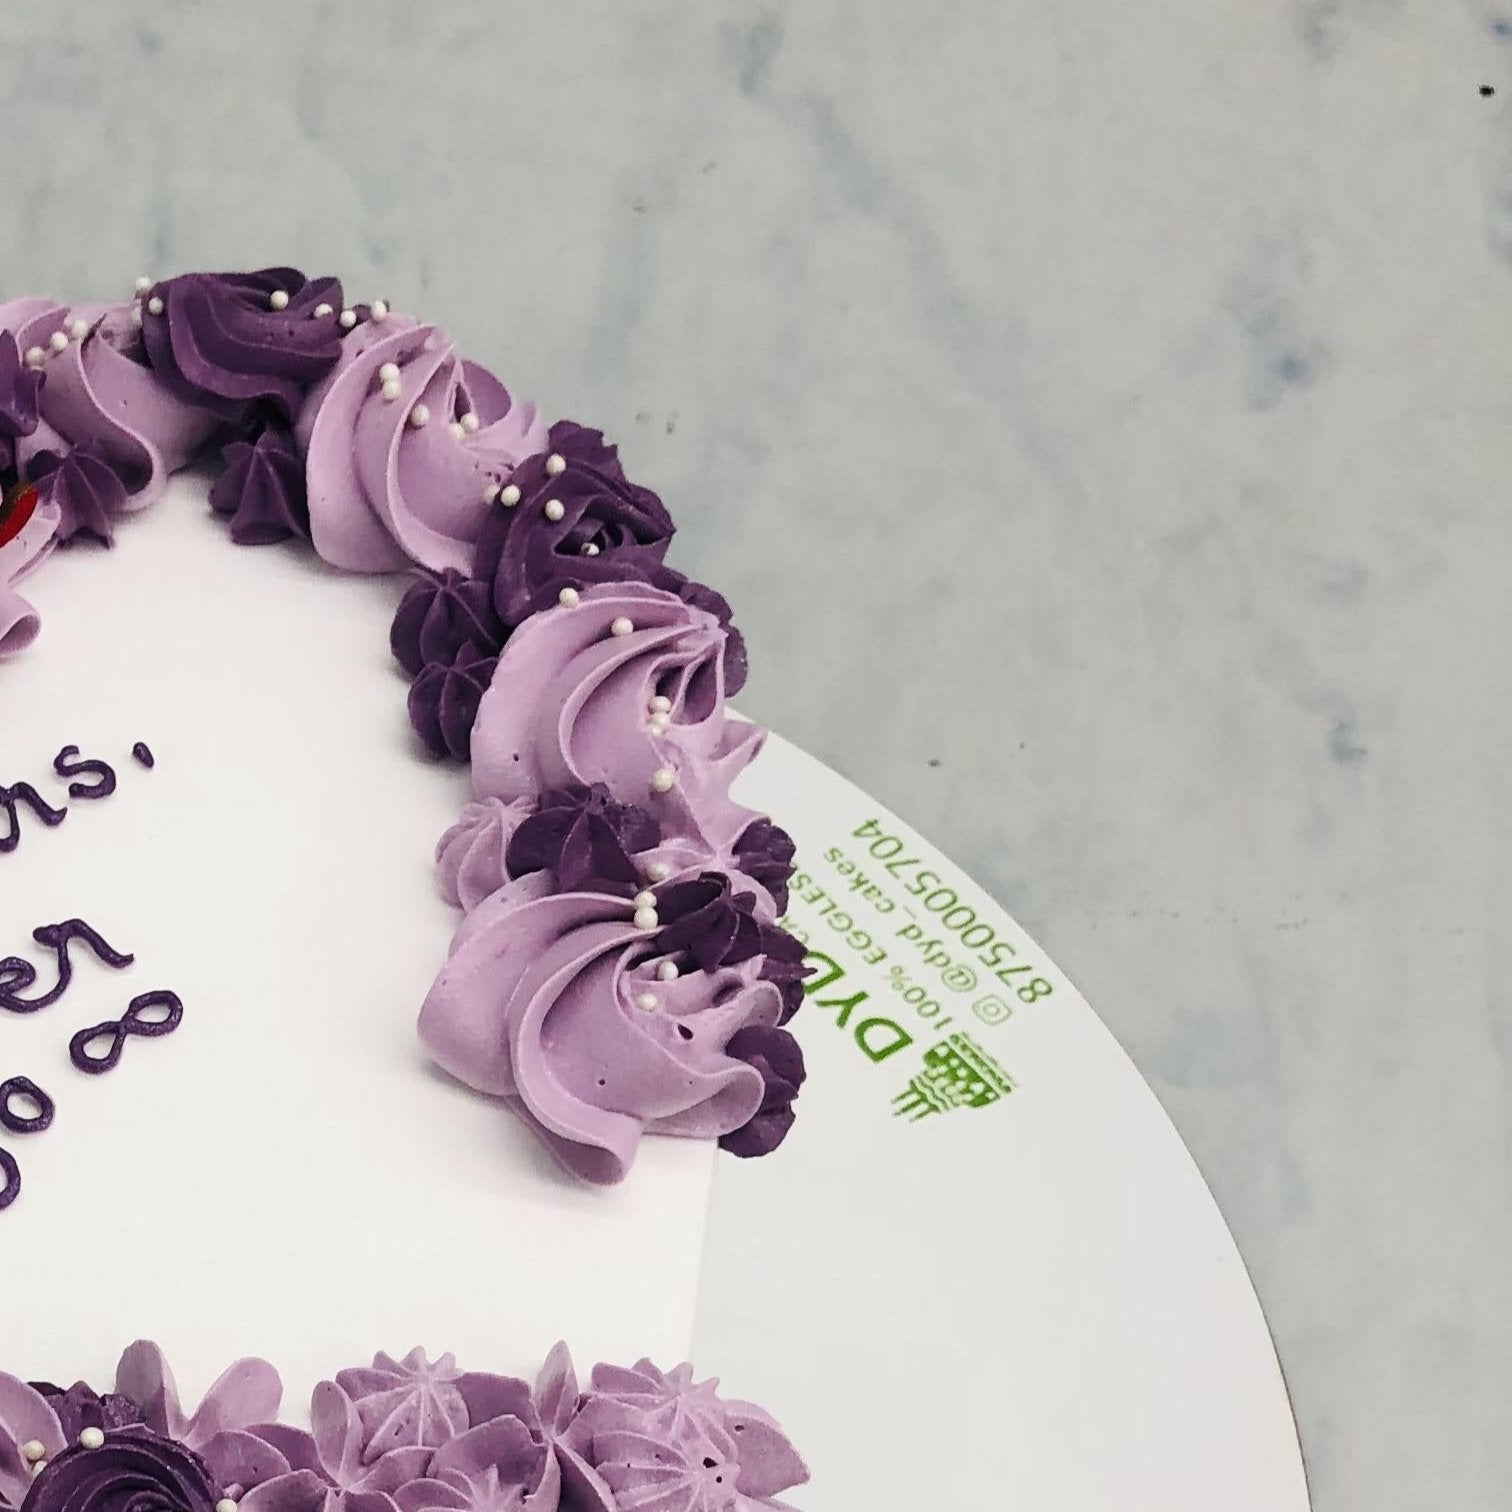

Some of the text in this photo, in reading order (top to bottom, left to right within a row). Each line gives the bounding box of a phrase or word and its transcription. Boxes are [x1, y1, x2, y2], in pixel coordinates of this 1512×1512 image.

[787, 862, 887, 965] EGGLES
[824, 847, 976, 992] @dyd_cakes
[853, 819, 1053, 1003] 8750005704
